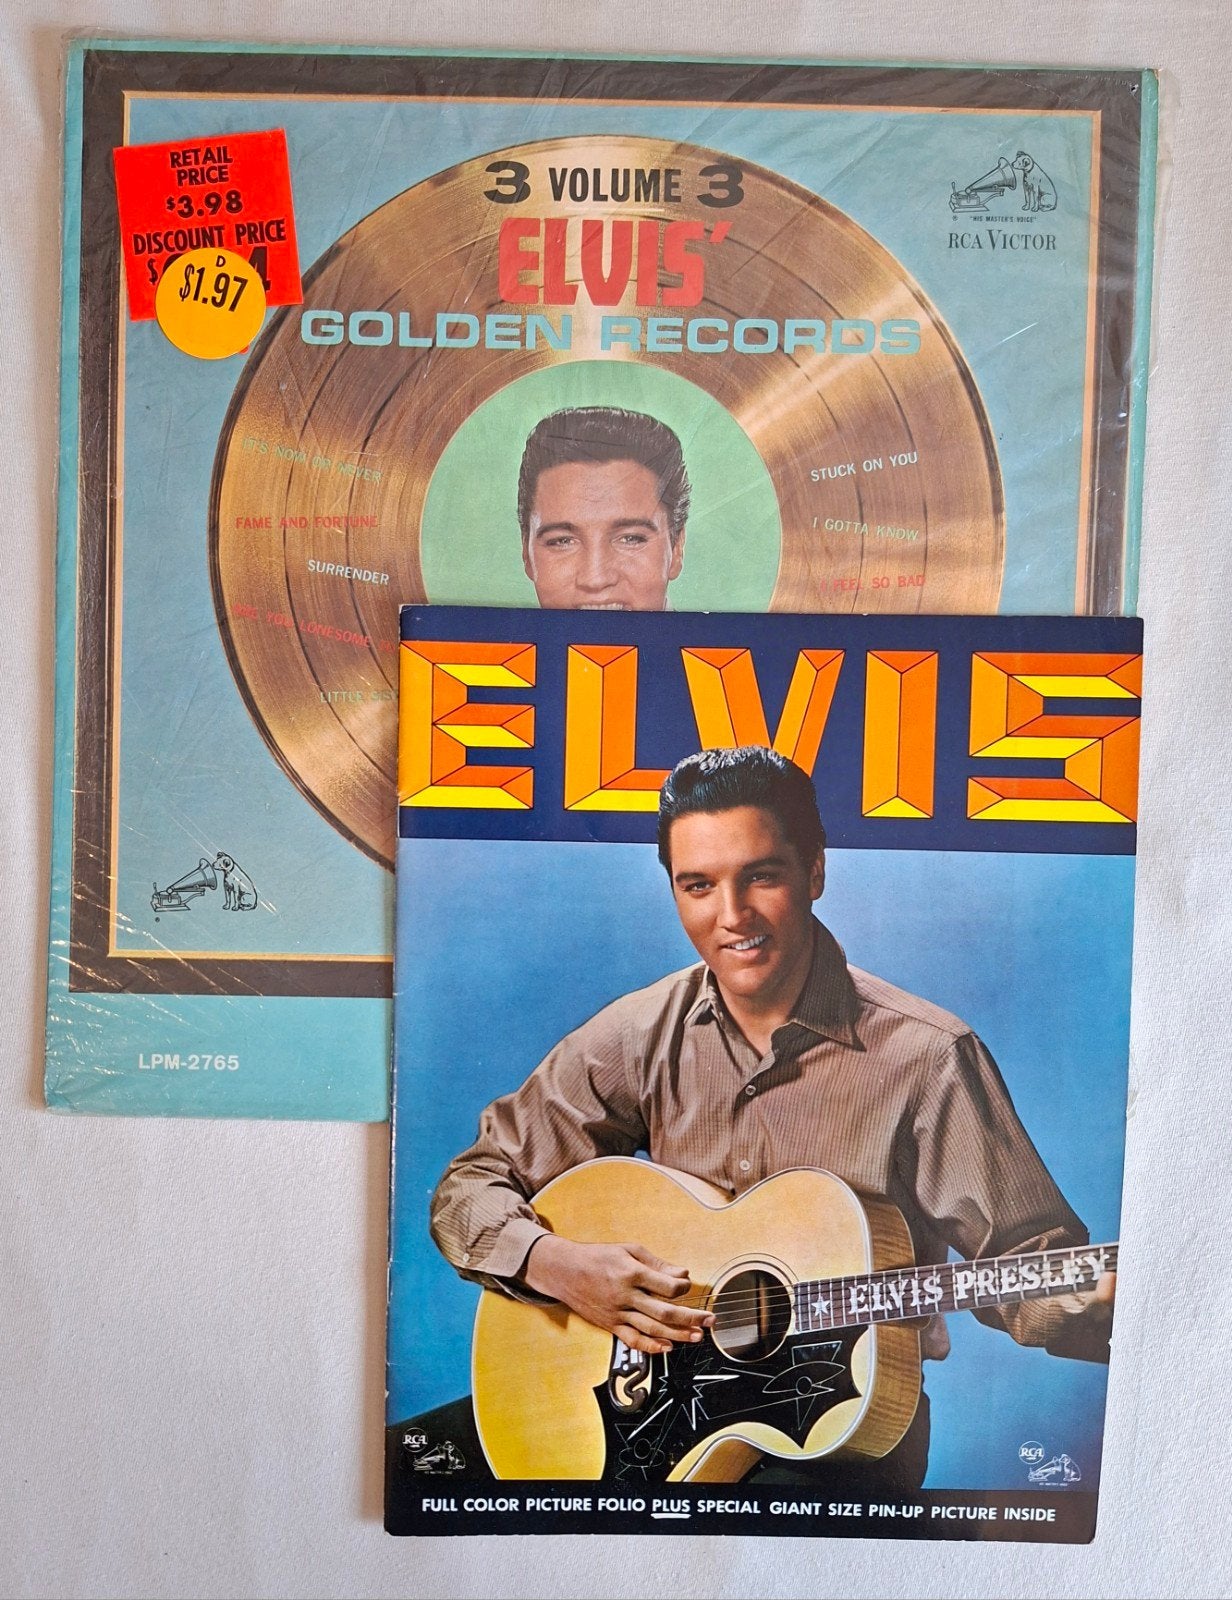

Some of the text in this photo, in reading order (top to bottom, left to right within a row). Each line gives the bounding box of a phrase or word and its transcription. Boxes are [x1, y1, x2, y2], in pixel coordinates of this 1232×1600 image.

[170, 146, 233, 168] RETAIL
[177, 165, 230, 186] PRICE
[483, 160, 745, 209] 3 VOLUME 3
[166, 190, 243, 218] $3.98
[133, 218, 286, 255] DISCOUNT PRICE
[948, 232, 983, 249] RCA
[216, 255, 226, 268] D
[179, 264, 248, 312] $1.97
[300, 310, 922, 355] GOLDEN RECORDS
[242, 437, 382, 483] IT'S NOW OR NEVER
[810, 452, 918, 482] STUCK ON YOU
[236, 515, 378, 529] FAME AND FORTUNE
[812, 517, 919, 541] I GOTTA KNOW
[307, 559, 390, 586] SURRENDER
[820, 574, 926, 592] I FEEL SO BAD
[232, 602, 258, 620] ARE
[266, 611, 294, 629] YOU
[300, 619, 371, 648] LONESOME
[320, 691, 363, 703] LITTLE
[400, 640, 1142, 823] ELVIS
[138, 1054, 240, 1071] LPM-2765
[847, 1252, 1110, 1314] ELVIS PRESLEY
[402, 1434, 428, 1444] RCA
[1019, 1448, 1044, 1457] RCA
[422, 1498, 1056, 1522] FULL COLOR PICTURE FOLIO PLUS SPECIAL GIANT SIZE PIN-UP PICTURE INSIDE
